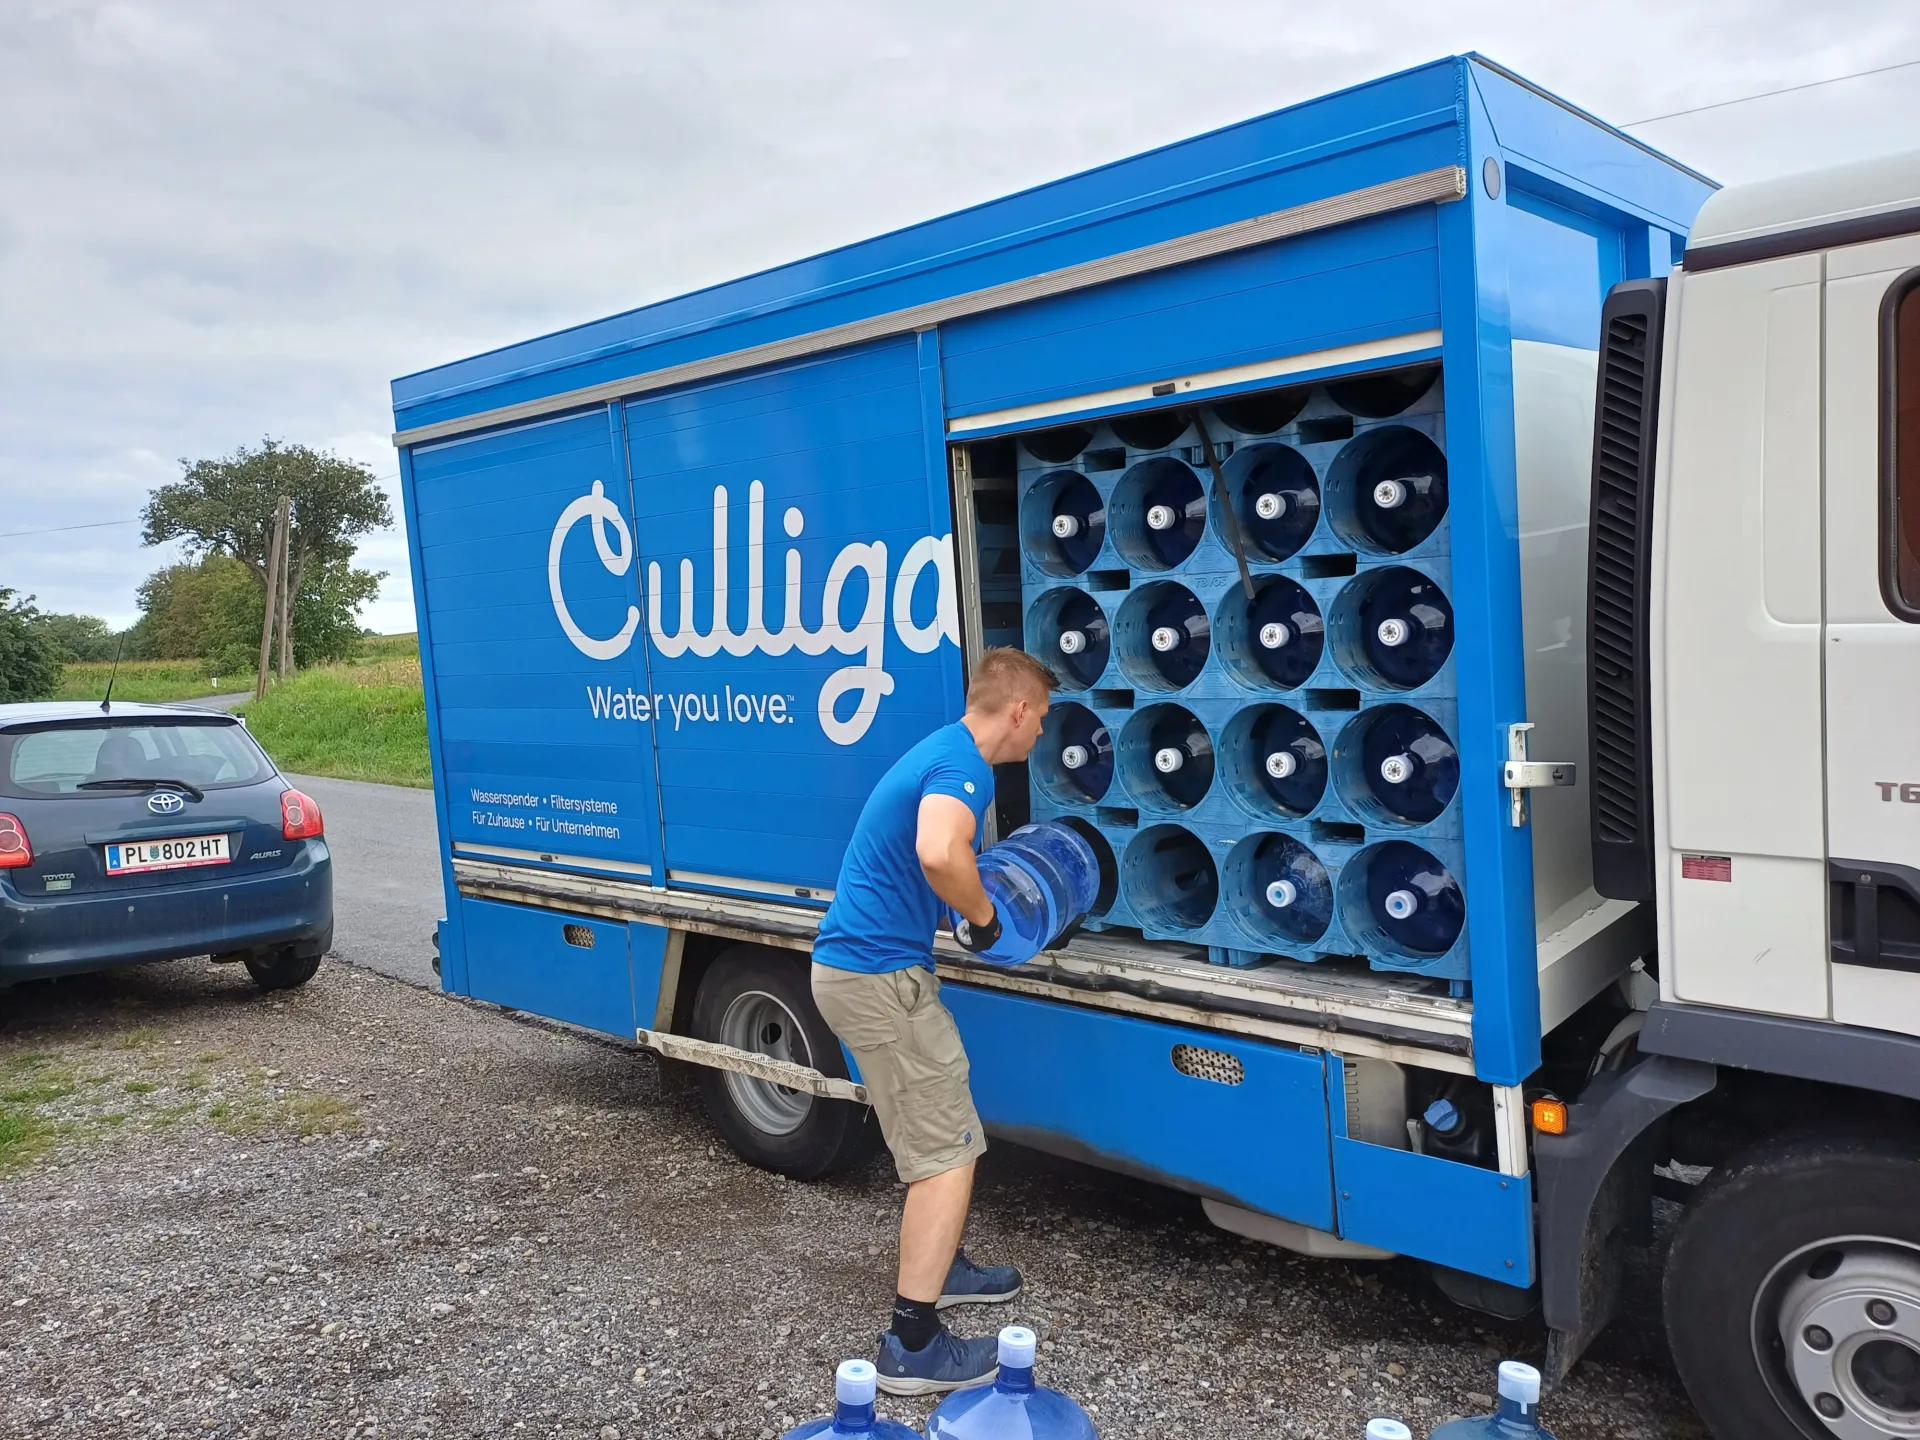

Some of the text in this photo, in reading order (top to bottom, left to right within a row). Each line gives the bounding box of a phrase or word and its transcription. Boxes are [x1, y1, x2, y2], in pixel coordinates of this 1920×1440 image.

[586, 686, 663, 722] Water
[668, 693, 719, 732] you
[470, 788, 618, 815] Wasserspender Filtersysteme
[472, 811, 620, 839] Für Zuhause Für Unternehmen
[125, 839, 221, 864] PL 802 HT
[250, 850, 282, 860] AURIS
[42, 873, 75, 881] TOYOTA
